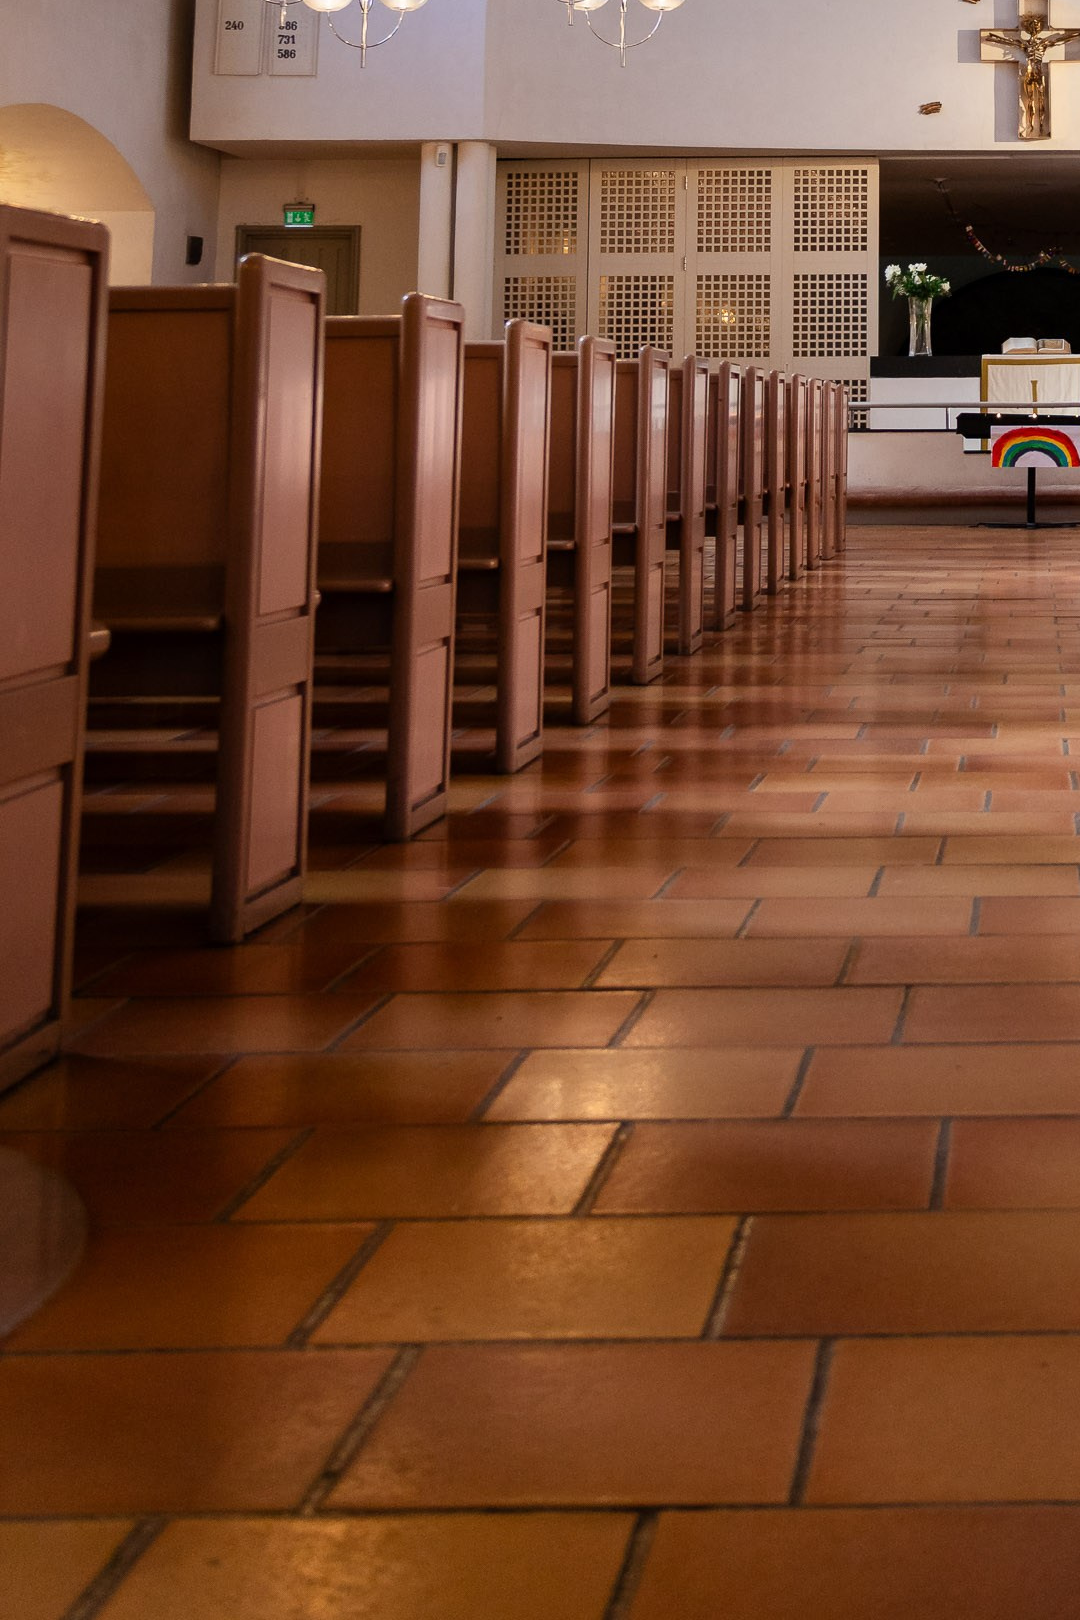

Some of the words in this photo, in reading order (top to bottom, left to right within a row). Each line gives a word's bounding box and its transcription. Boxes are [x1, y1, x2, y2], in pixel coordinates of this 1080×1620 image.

[225, 21, 244, 30] 240
[278, 35, 295, 44] 731
[277, 49, 296, 59] 586
